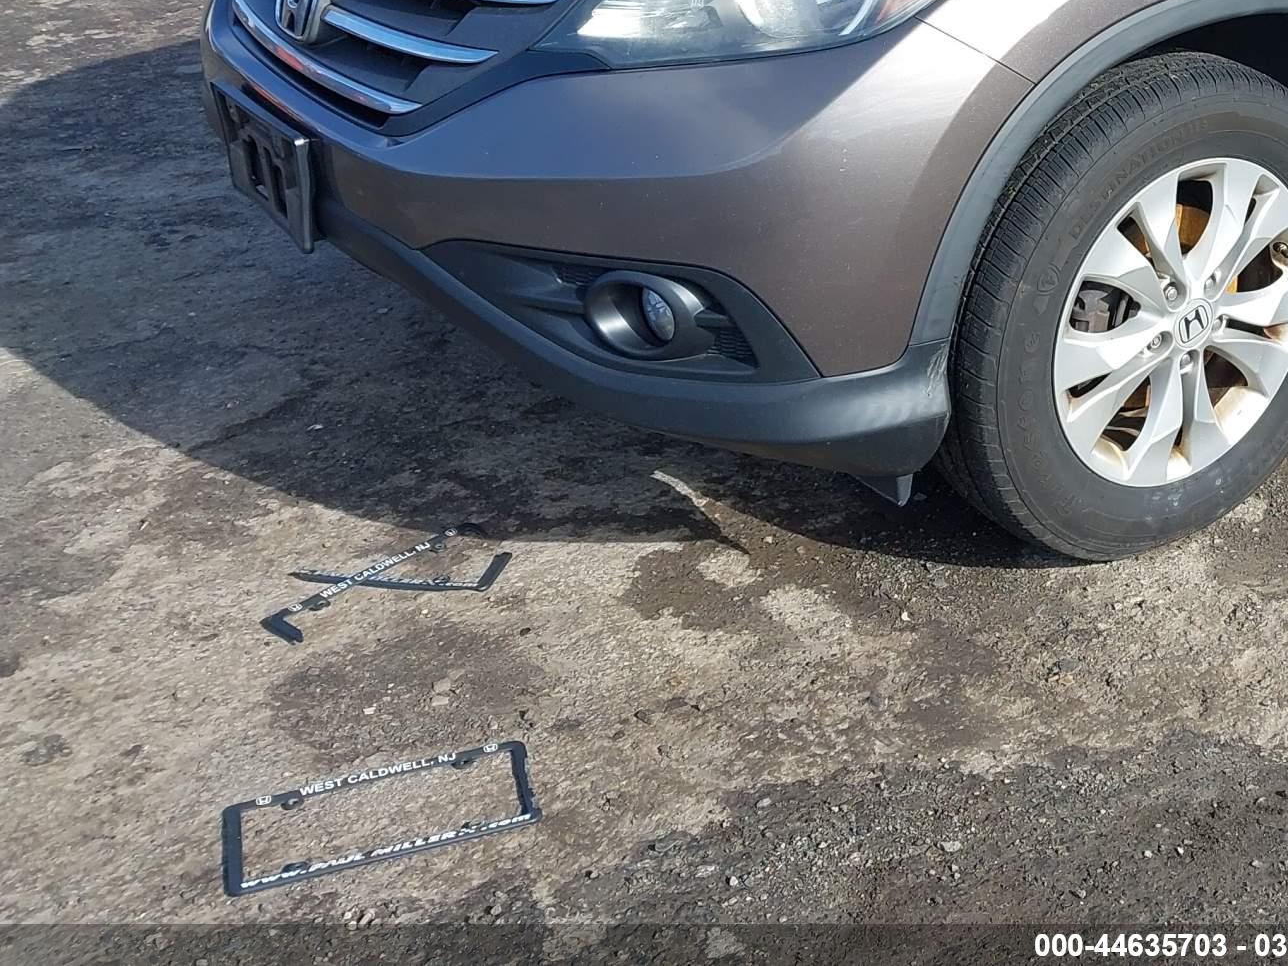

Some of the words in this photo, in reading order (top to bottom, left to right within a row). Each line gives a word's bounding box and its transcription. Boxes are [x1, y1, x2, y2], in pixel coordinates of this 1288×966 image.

[320, 578, 353, 598] WEST
[415, 541, 431, 551] NJ
[300, 778, 343, 796] WEST
[438, 752, 457, 764] NJ
